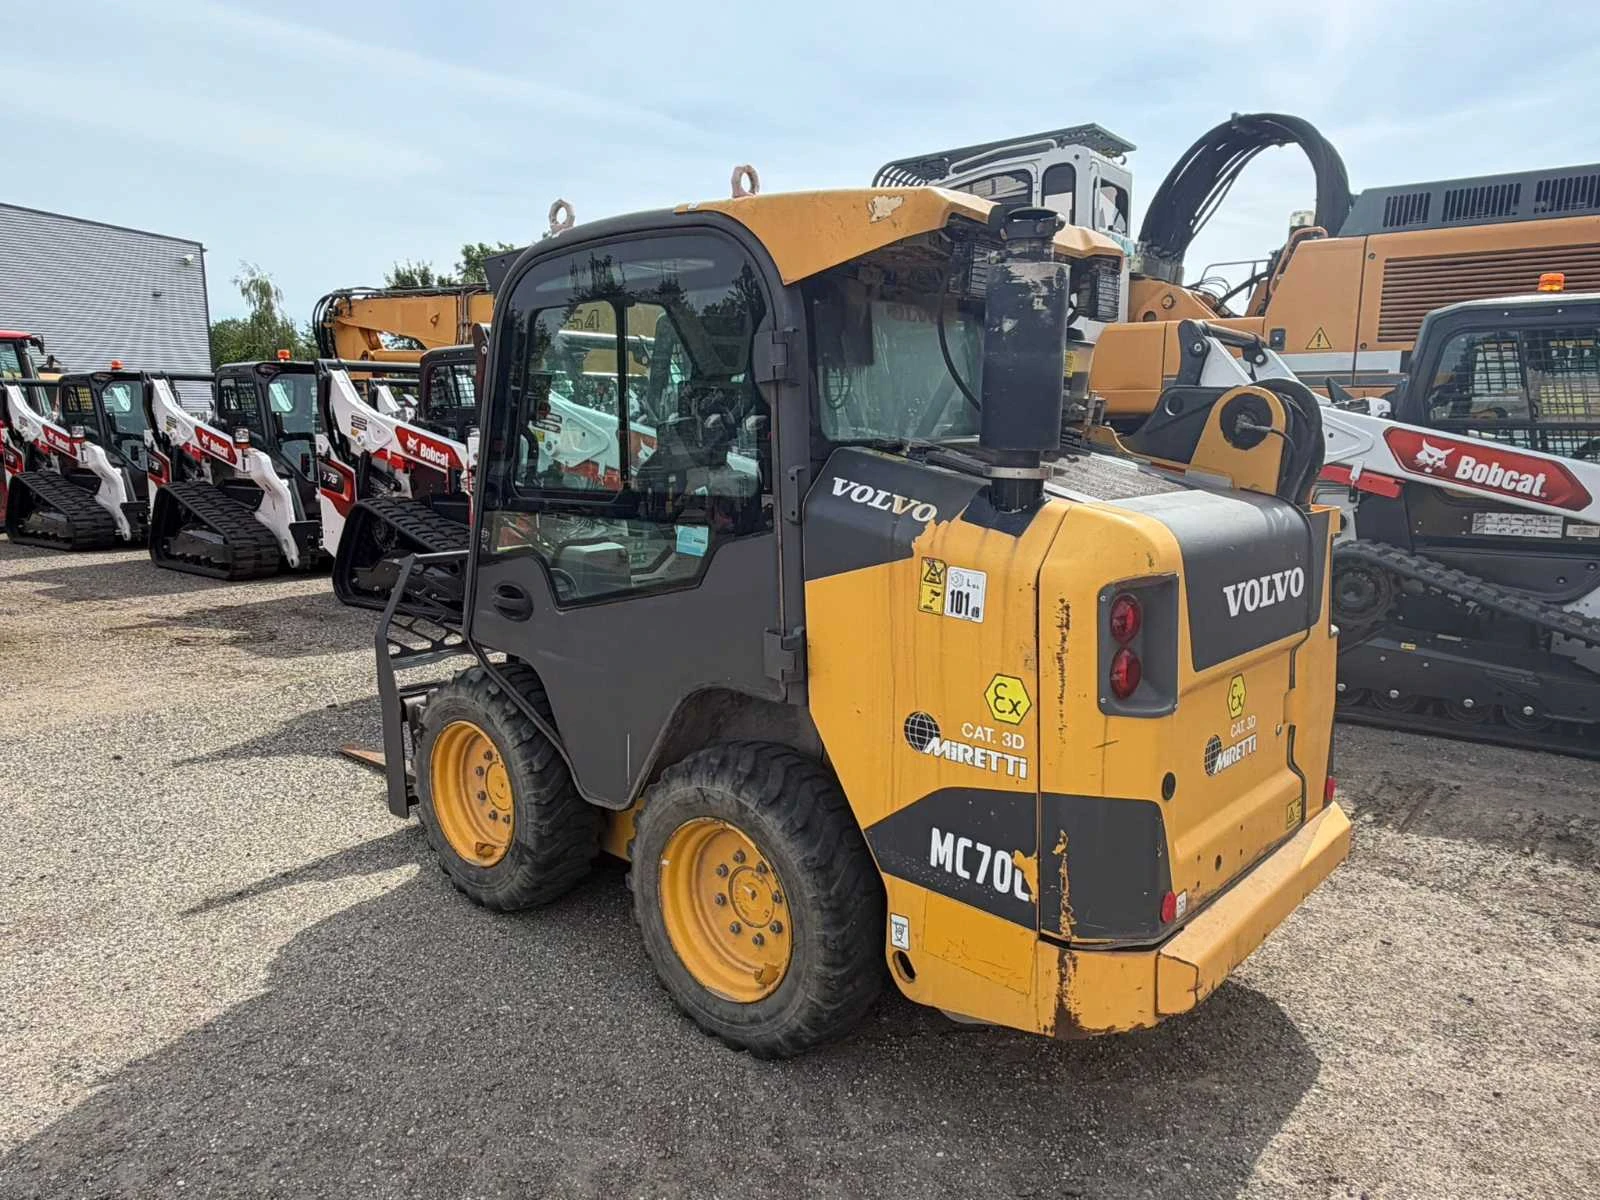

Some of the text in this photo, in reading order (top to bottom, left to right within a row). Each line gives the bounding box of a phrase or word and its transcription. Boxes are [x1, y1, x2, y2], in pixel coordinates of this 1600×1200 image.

[420, 442, 450, 466] Bobcat
[1454, 455, 1546, 497] Bobcat
[831, 476, 938, 523] VOLVO
[949, 588, 971, 615] 101
[1222, 567, 1305, 618] VOLVO
[961, 723, 1026, 751] CAT. 3D
